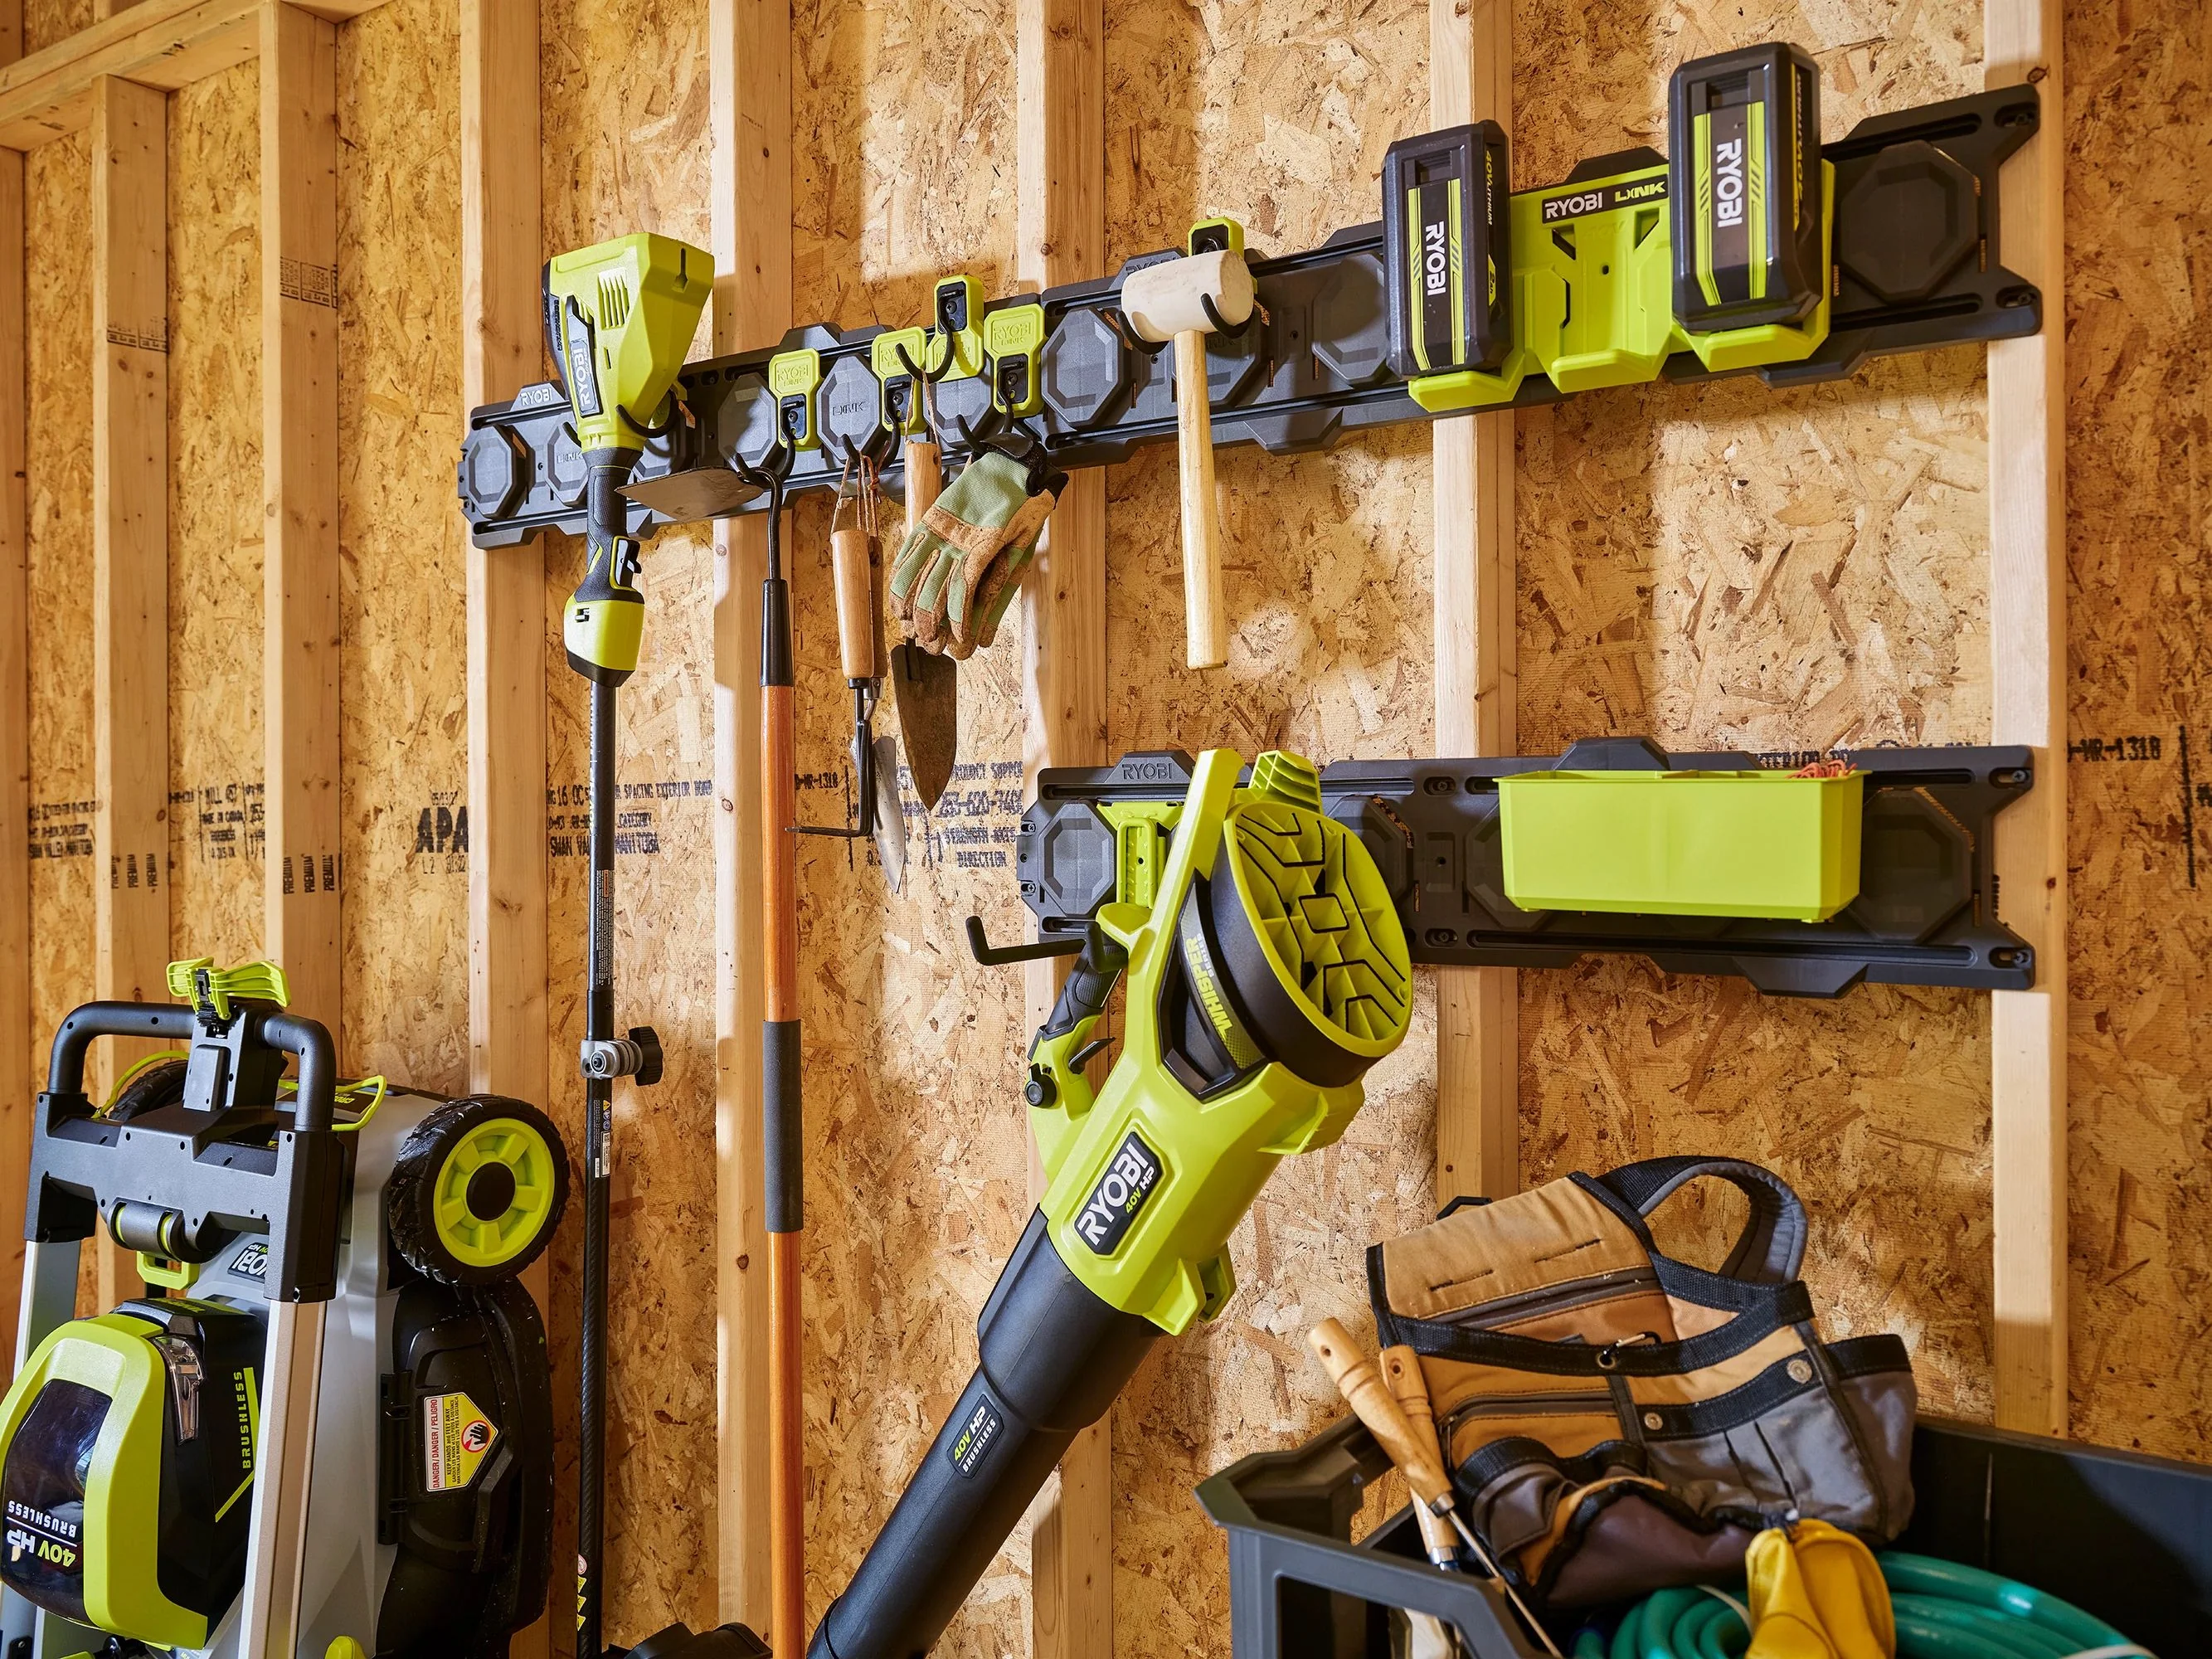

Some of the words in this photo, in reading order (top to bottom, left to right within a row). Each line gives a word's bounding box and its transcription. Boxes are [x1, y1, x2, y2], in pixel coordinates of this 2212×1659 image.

[1717, 139, 1743, 228] RYOBI
[1544, 192, 1602, 219] RYOBI
[1425, 221, 1446, 296] RYOBI
[994, 322, 1031, 340] RYOBI
[574, 348, 591, 406] RYOBI
[776, 364, 808, 382] RYOBI
[520, 388, 552, 406] RYOBI
[1122, 762, 1173, 780] RYOBI
[625, 783, 654, 800] SPACING
[656, 781, 690, 800] EXTERIOR
[416, 806, 469, 853] APA
[576, 834, 590, 856] VAL
[146, 853, 158, 887] PREMIUM
[283, 857, 294, 894] PREMIUM
[304, 856, 315, 893] PREMIUM
[323, 854, 335, 891] PREMIUM
[1185, 936, 1233, 1041] WHISPER
[1077, 1141, 1149, 1246] RYOBI
[1125, 1186, 1142, 1214] 40V
[1140, 1165, 1155, 1190] HP
[232, 1250, 268, 1276] OBI
[233, 1371, 251, 1469] BRUSHLESS
[953, 1430, 973, 1461] 40V
[970, 1405, 987, 1433] HP
[961, 1418, 997, 1473] BRUSHLESS
[8, 1500, 77, 1538] BRUSHLESS
[7, 1530, 36, 1554] HP
[38, 1539, 76, 1567] 40V
